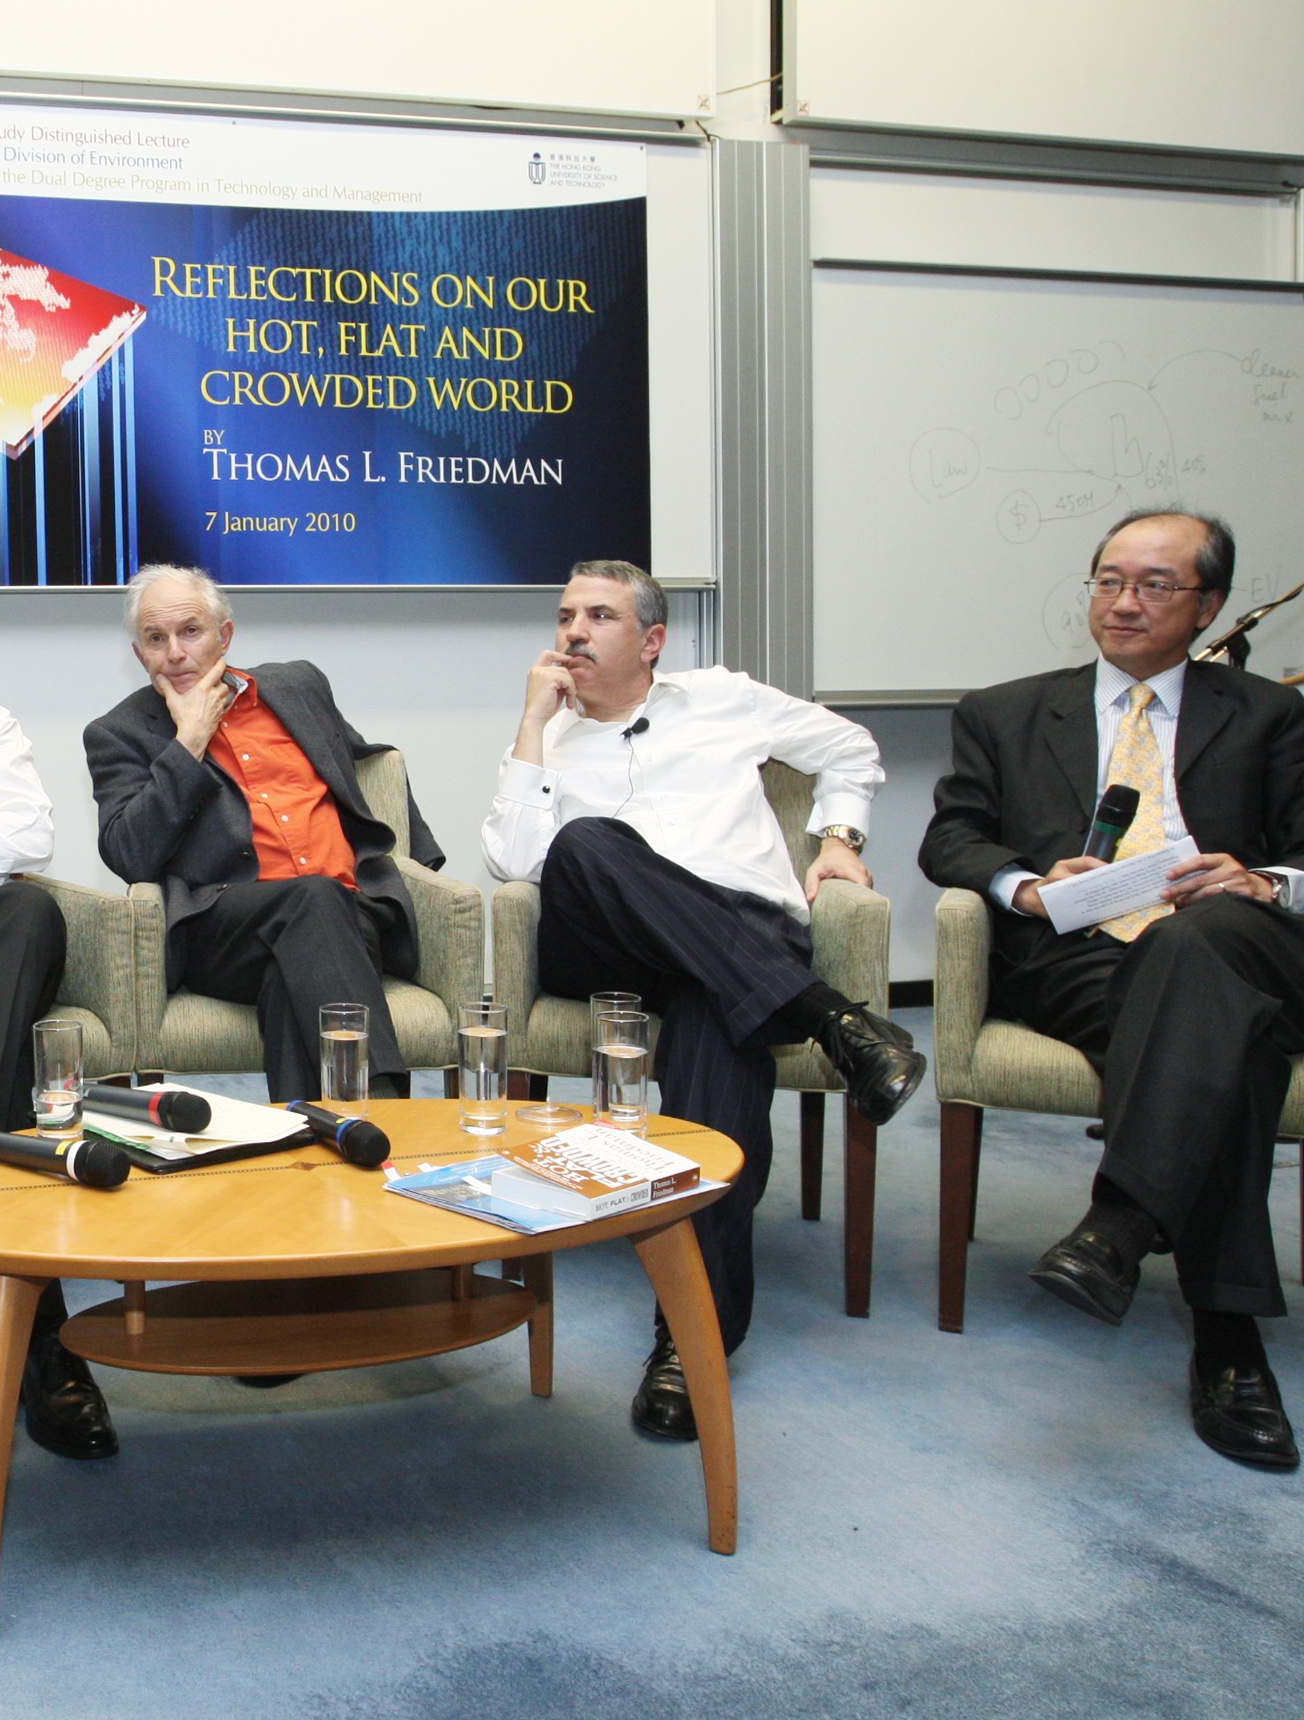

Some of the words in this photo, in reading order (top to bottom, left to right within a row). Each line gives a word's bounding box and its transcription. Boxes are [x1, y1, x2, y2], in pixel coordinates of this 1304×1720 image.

[30, 125, 132, 147] Distinguished
[137, 131, 191, 149] Lecture
[3, 146, 66, 164] Division
[70, 150, 86, 165] of
[89, 151, 184, 170] Environment
[561, 163, 582, 171] HONG
[1, 168, 26, 185] the
[30, 169, 67, 186] Dual
[72, 172, 127, 191] Degree
[130, 174, 192, 193] Program
[196, 177, 210, 193] in
[214, 179, 298, 201] Technology
[302, 183, 329, 199] and
[332, 186, 424, 204] Management
[549, 171, 583, 179] UNIVERSITY
[593, 173, 618, 181] SCIENCE
[431, 273, 494, 311] ON
[506, 277, 595, 314] OUR
[226, 318, 326, 359] HOT,
[337, 321, 426, 359] FLAT
[435, 326, 524, 362] AND
[200, 370, 417, 411] CROWDED
[425, 376, 574, 414] WORLD
[203, 429, 225, 445] BY
[362, 450, 386, 483] L.
[205, 511, 217, 532] 7
[223, 512, 298, 537] January
[305, 513, 357, 533] 2010
[540, 1139, 639, 1184] CROWDED
[653, 1179, 671, 1190] Thomas
[653, 1188, 675, 1198] Friedman
